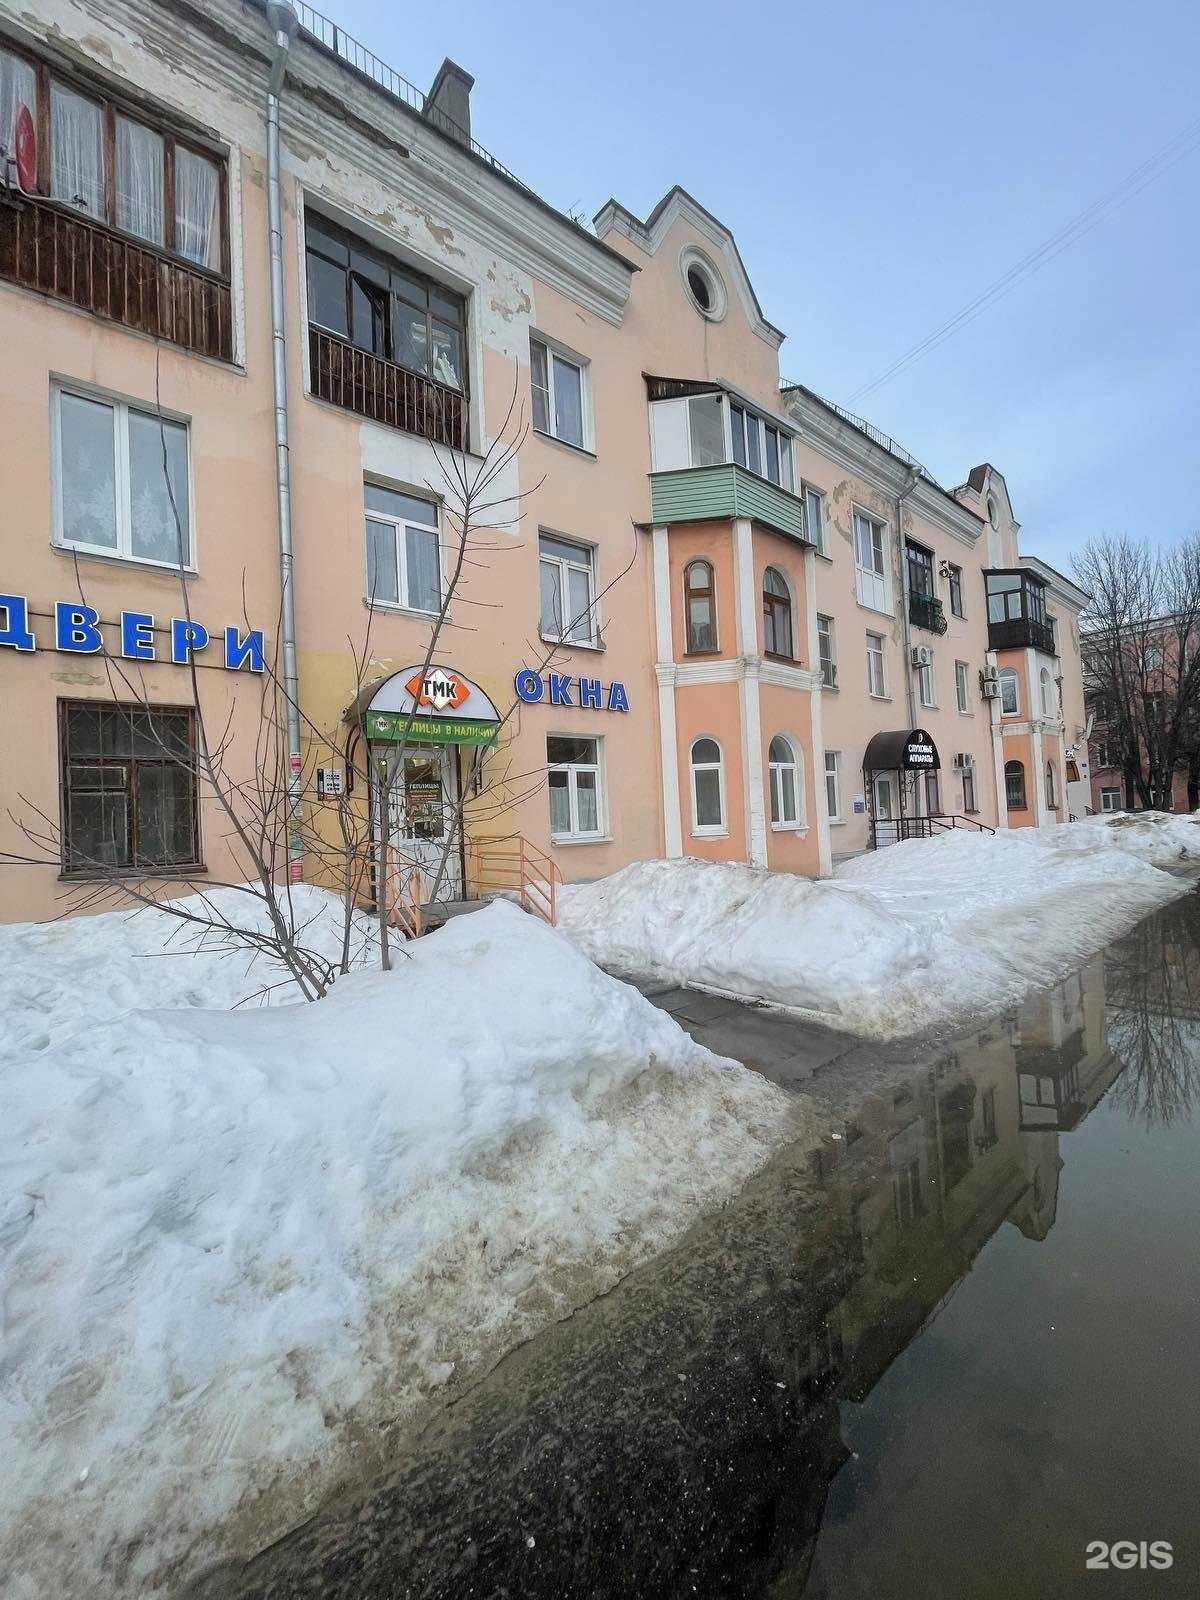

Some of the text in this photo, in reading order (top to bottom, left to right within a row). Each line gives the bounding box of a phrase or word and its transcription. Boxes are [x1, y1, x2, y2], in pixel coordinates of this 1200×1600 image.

[0, 593, 265, 673] ДВЕРИ
[422, 679, 457, 699] ТМК
[515, 667, 630, 712] ОКНА
[446, 725, 452, 735] В
[909, 754, 934, 763] АППАРАТЫ
